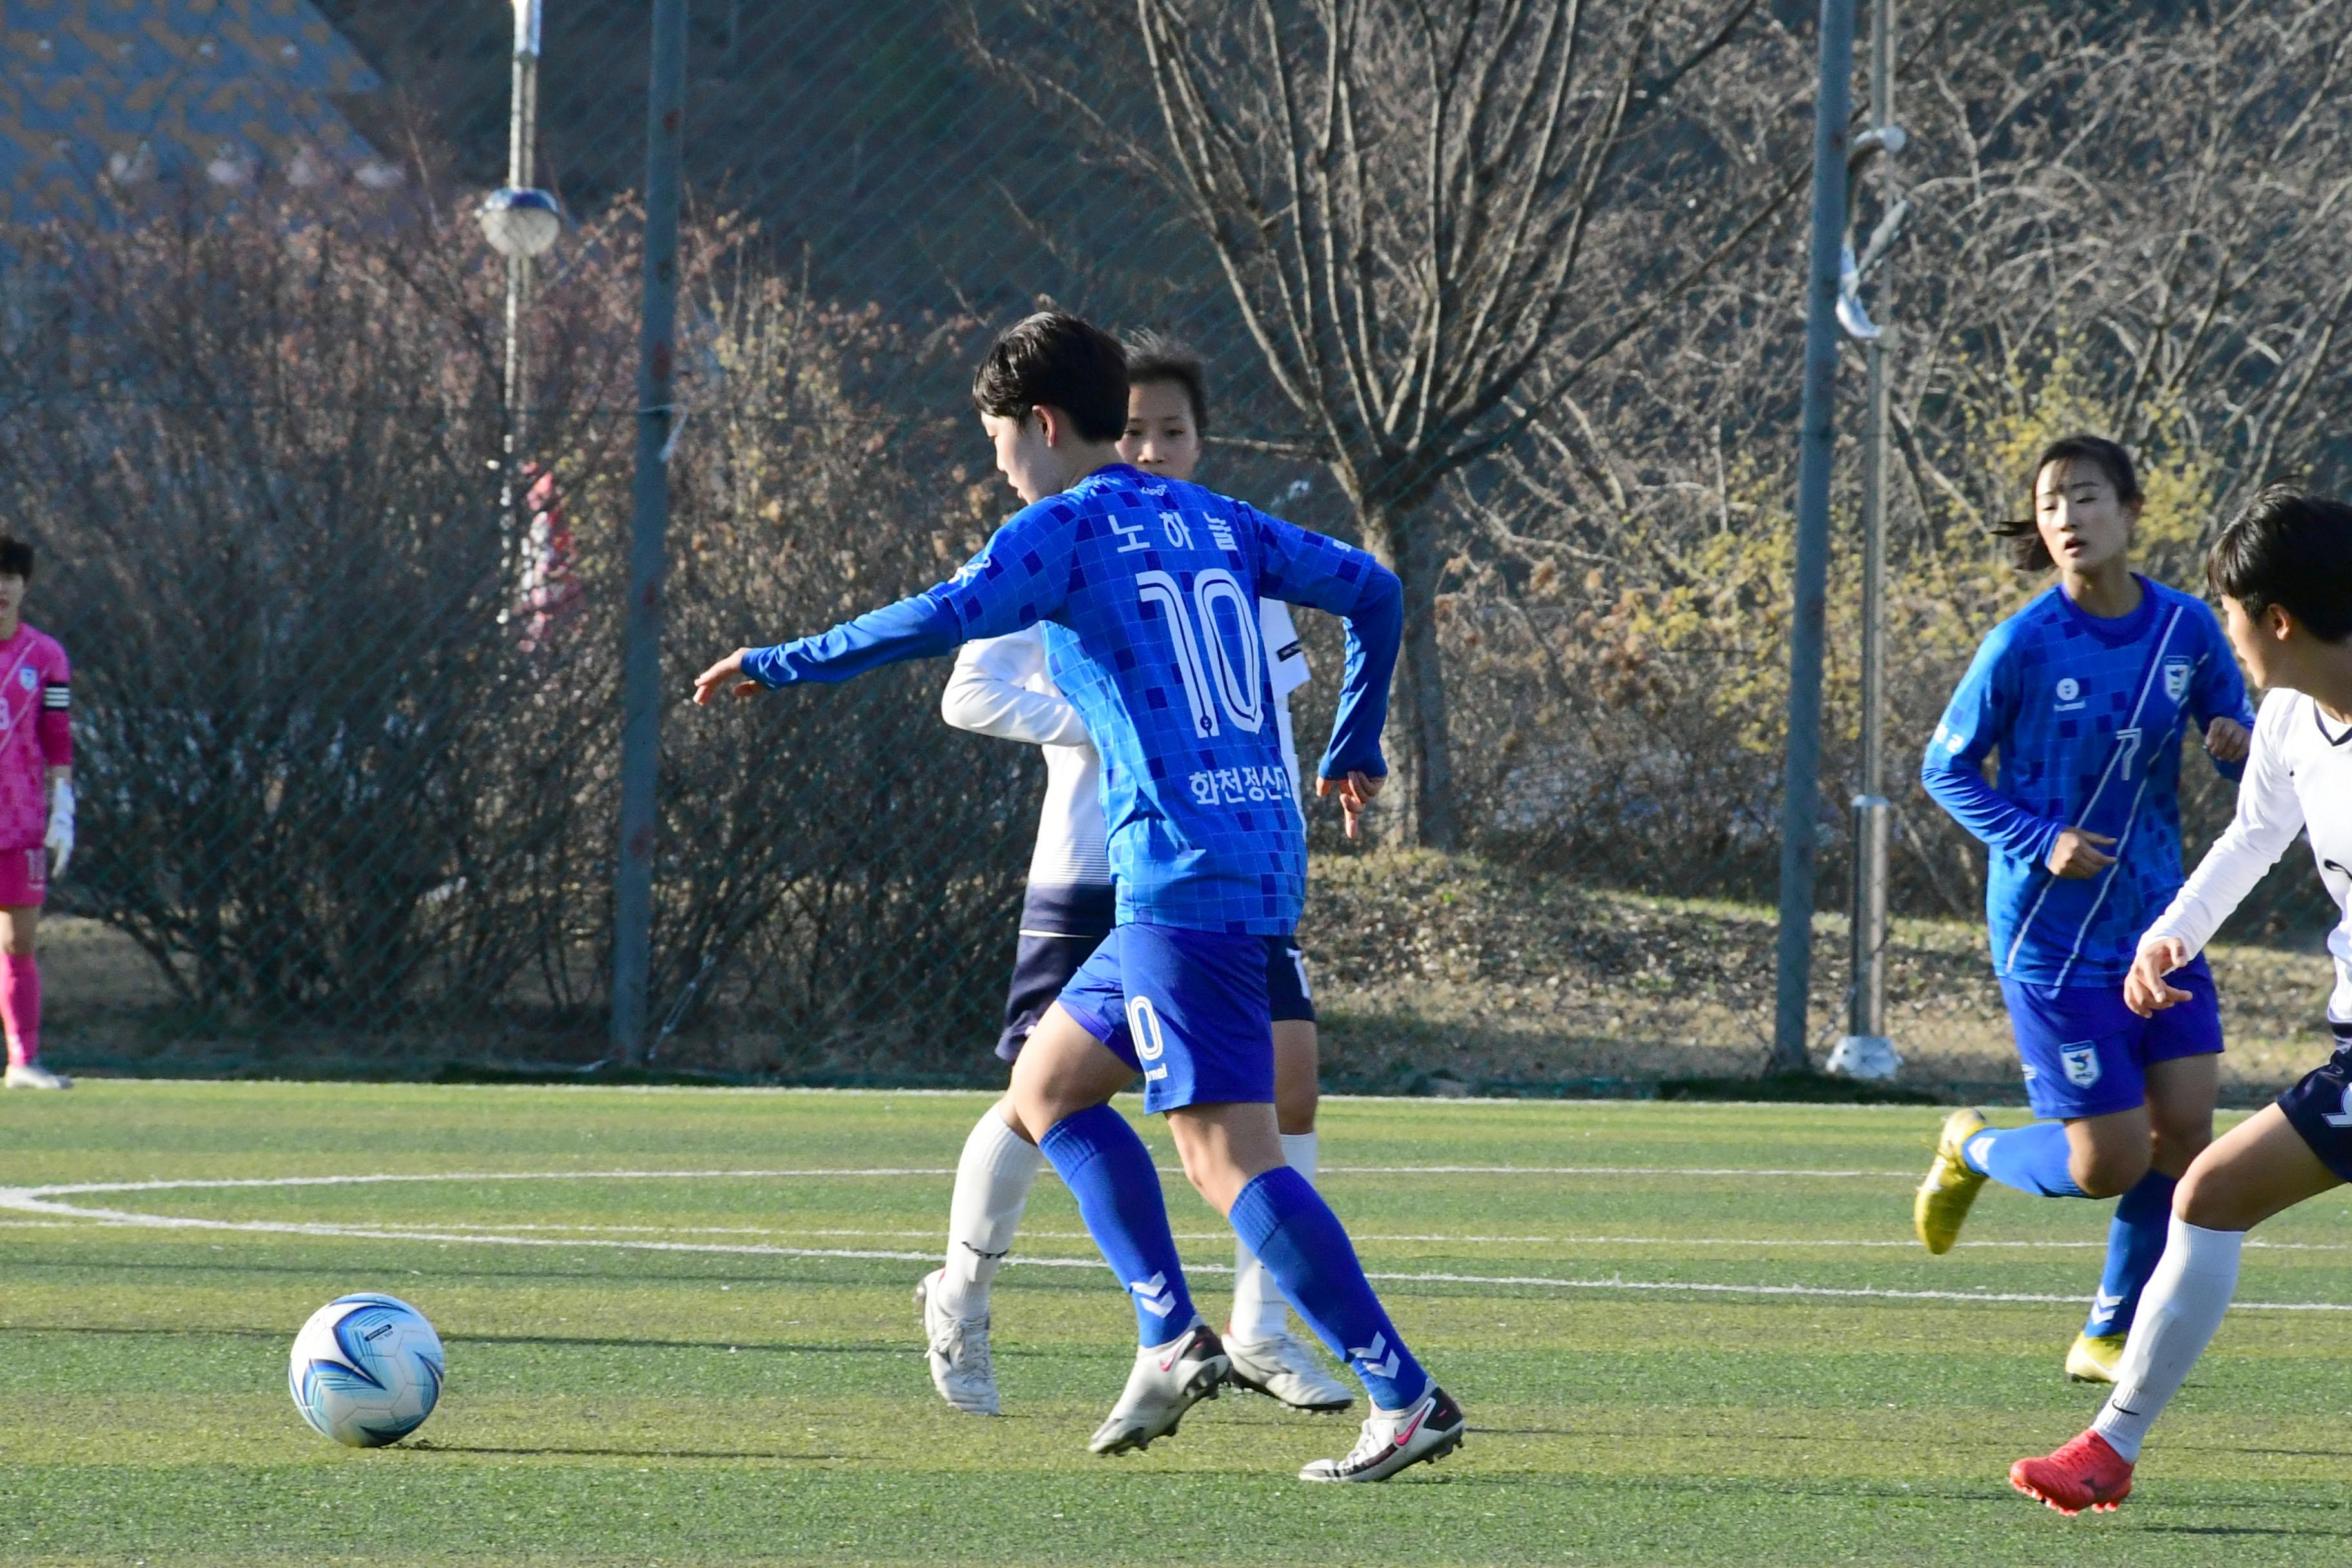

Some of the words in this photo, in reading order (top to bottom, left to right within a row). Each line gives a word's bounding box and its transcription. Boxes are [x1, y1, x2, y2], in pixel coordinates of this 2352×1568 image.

[1108, 511, 1238, 553] 노하늘
[1135, 568, 1264, 738] 10
[2116, 728, 2142, 781] 7
